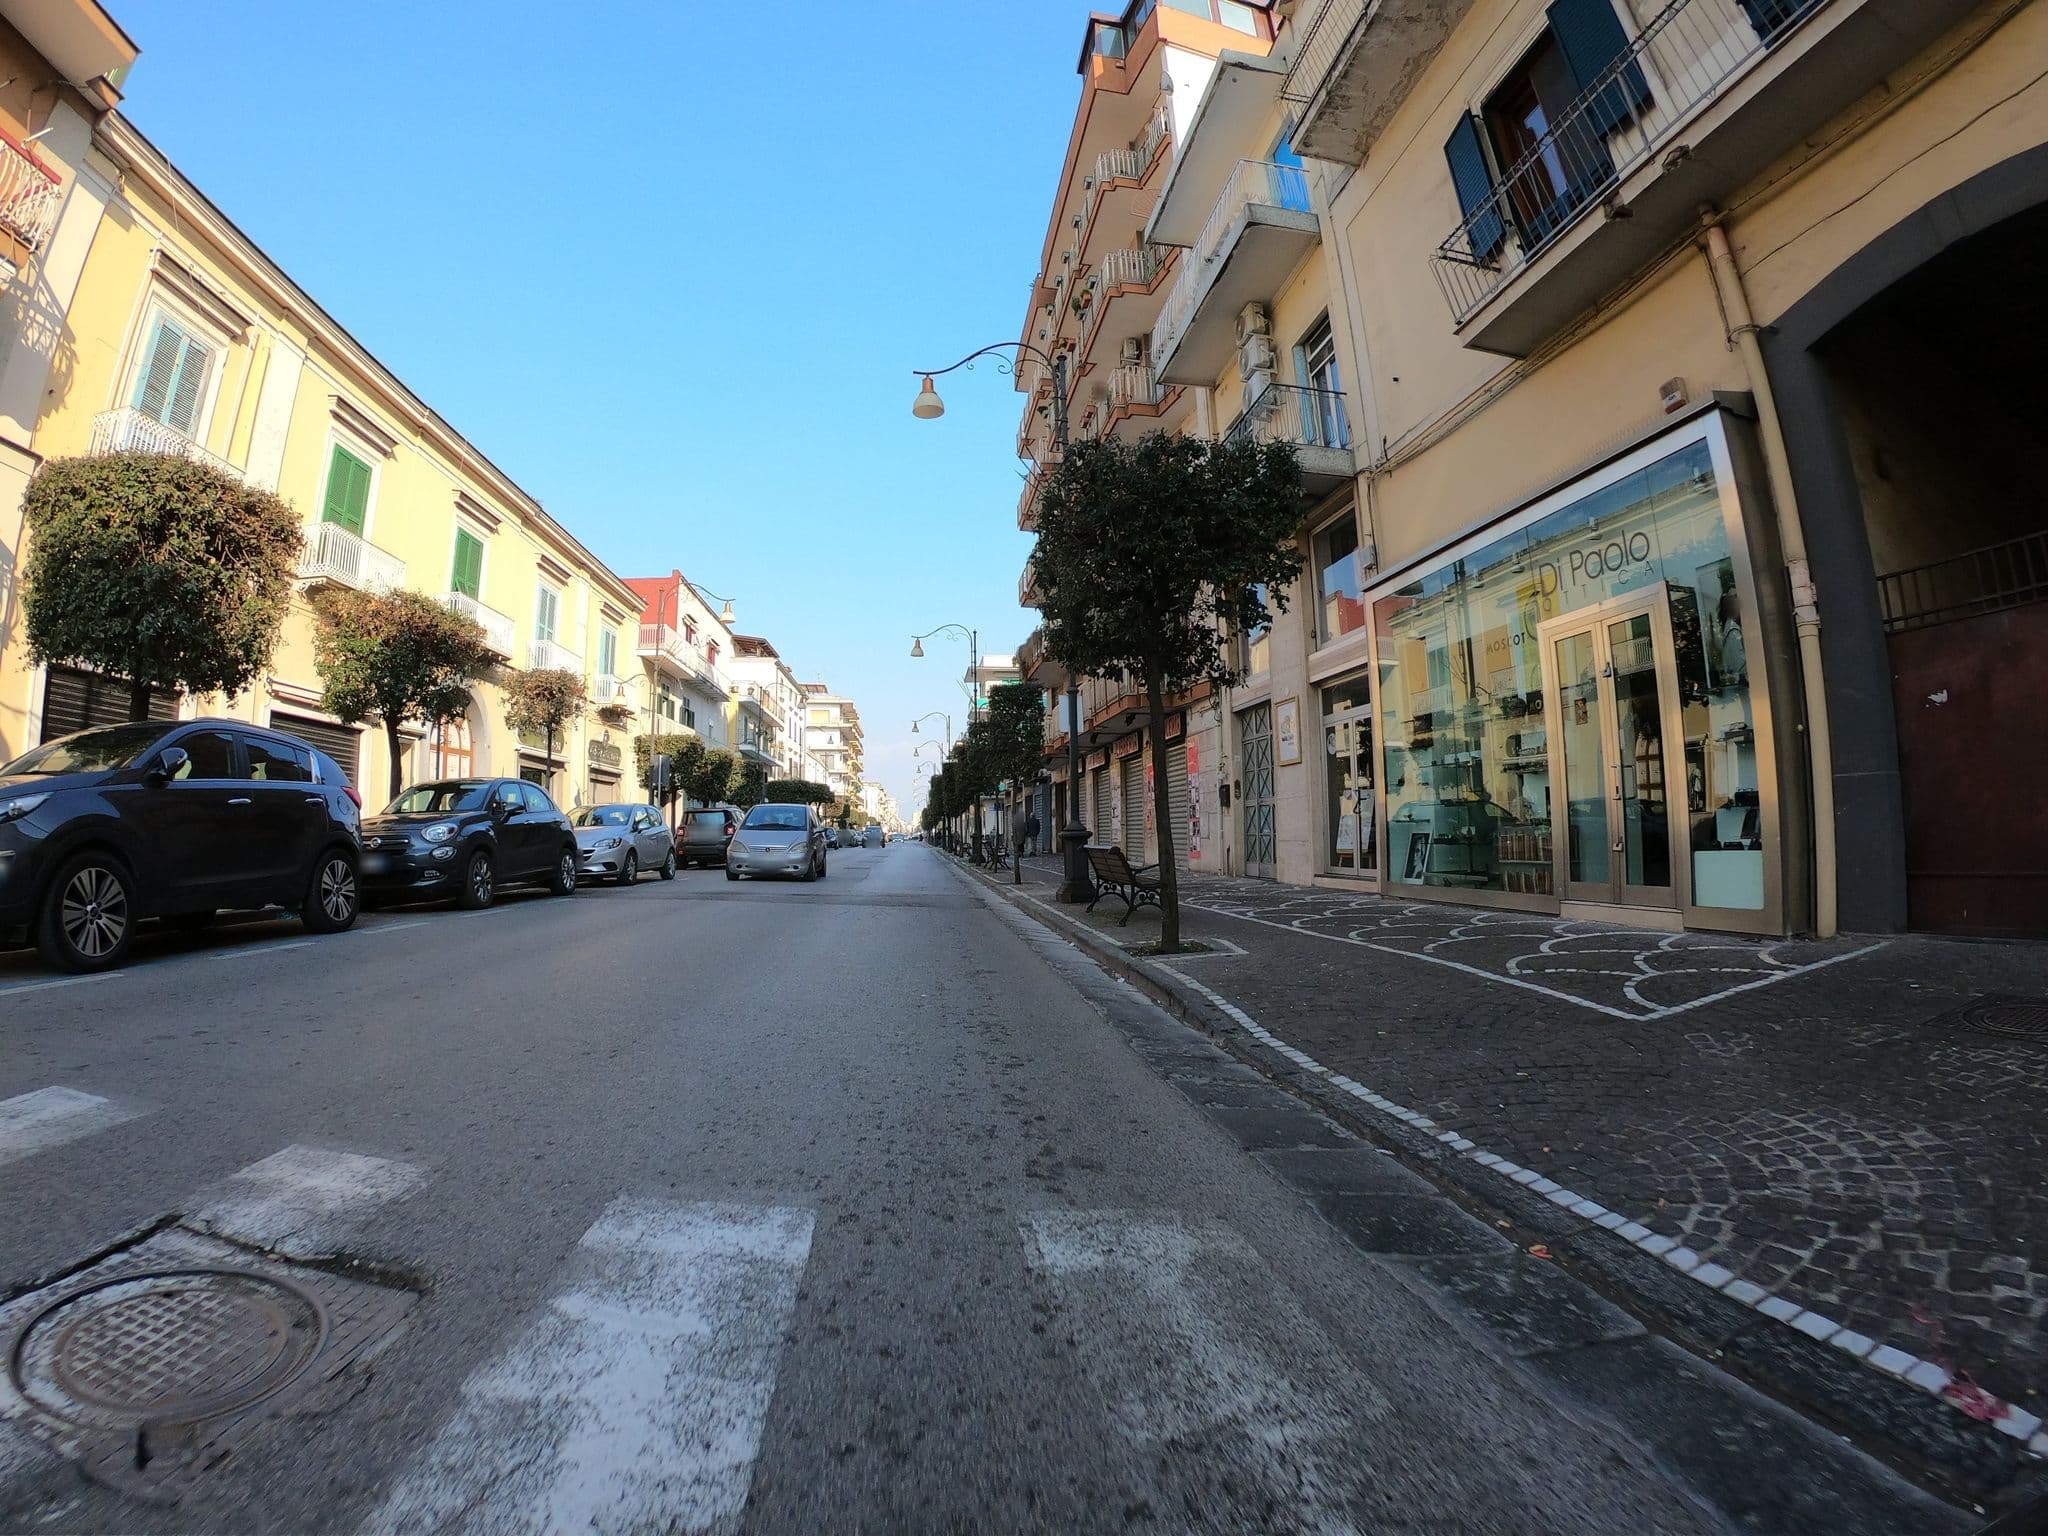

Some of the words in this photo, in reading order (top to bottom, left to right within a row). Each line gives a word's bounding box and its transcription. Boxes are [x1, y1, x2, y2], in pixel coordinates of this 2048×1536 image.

[1539, 558, 1564, 597] Di
[1570, 530, 1650, 586] Paolo
[1543, 561, 1654, 611] OTTICA
